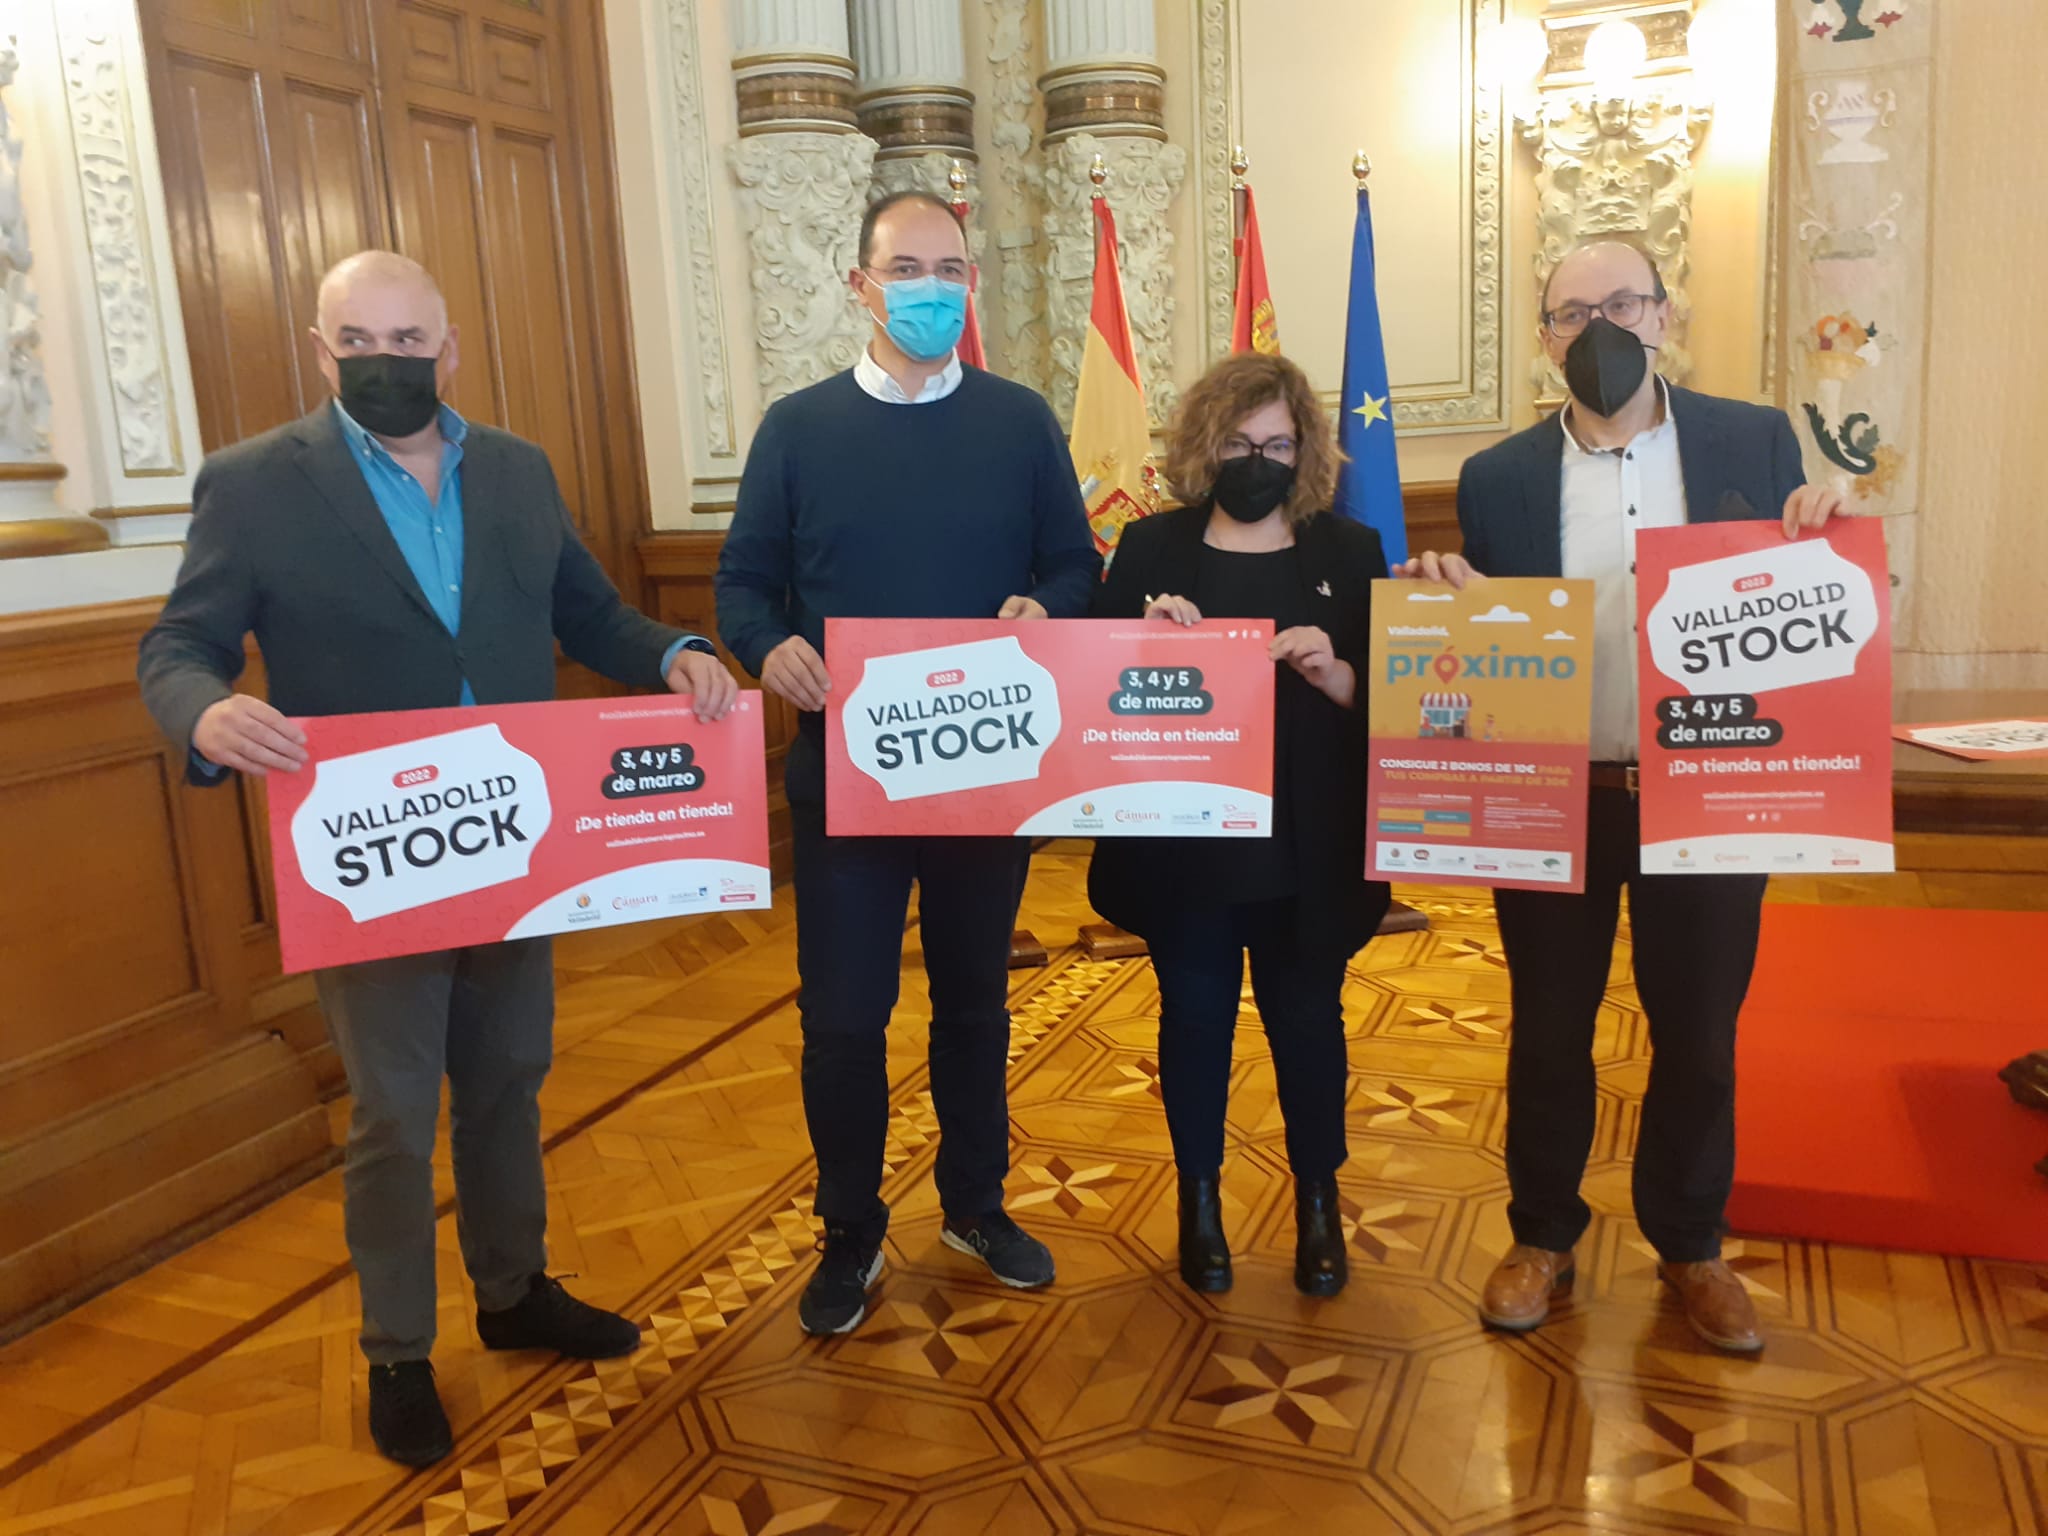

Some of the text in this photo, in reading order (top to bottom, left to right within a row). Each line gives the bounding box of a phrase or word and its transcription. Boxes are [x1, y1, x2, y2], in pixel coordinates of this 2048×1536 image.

[1741, 576, 1766, 590] 2022
[1672, 583, 1845, 633] VALLADOLID
[1680, 609, 1855, 675] STOCK
[1386, 645, 1576, 685] próximo
[933, 672, 959, 684] 2022
[1128, 671, 1190, 691] 3, 4 y 5
[867, 684, 1032, 727] VALLADOLID
[1119, 693, 1203, 709] de marzo
[1669, 698, 1743, 720] 3, 4 y 5
[875, 711, 1040, 770] STOCK
[1083, 728, 1239, 744] ¡De tienda en tienda!
[1669, 724, 1771, 742] de marzo
[620, 748, 683, 770] 3, 4 y 5
[1379, 758, 1438, 770] CONSIGUE
[1440, 761, 1448, 771] 2
[1450, 761, 1493, 772] BONOS
[1495, 763, 1512, 773] DE
[1668, 755, 1860, 776] ¡De tienda en tienda!
[401, 768, 431, 785] 2022
[612, 772, 696, 793] de marzo
[322, 775, 517, 838] VALLADOLID
[575, 802, 733, 834] ¡De tienda en tienda!
[334, 804, 528, 888] STOCK
